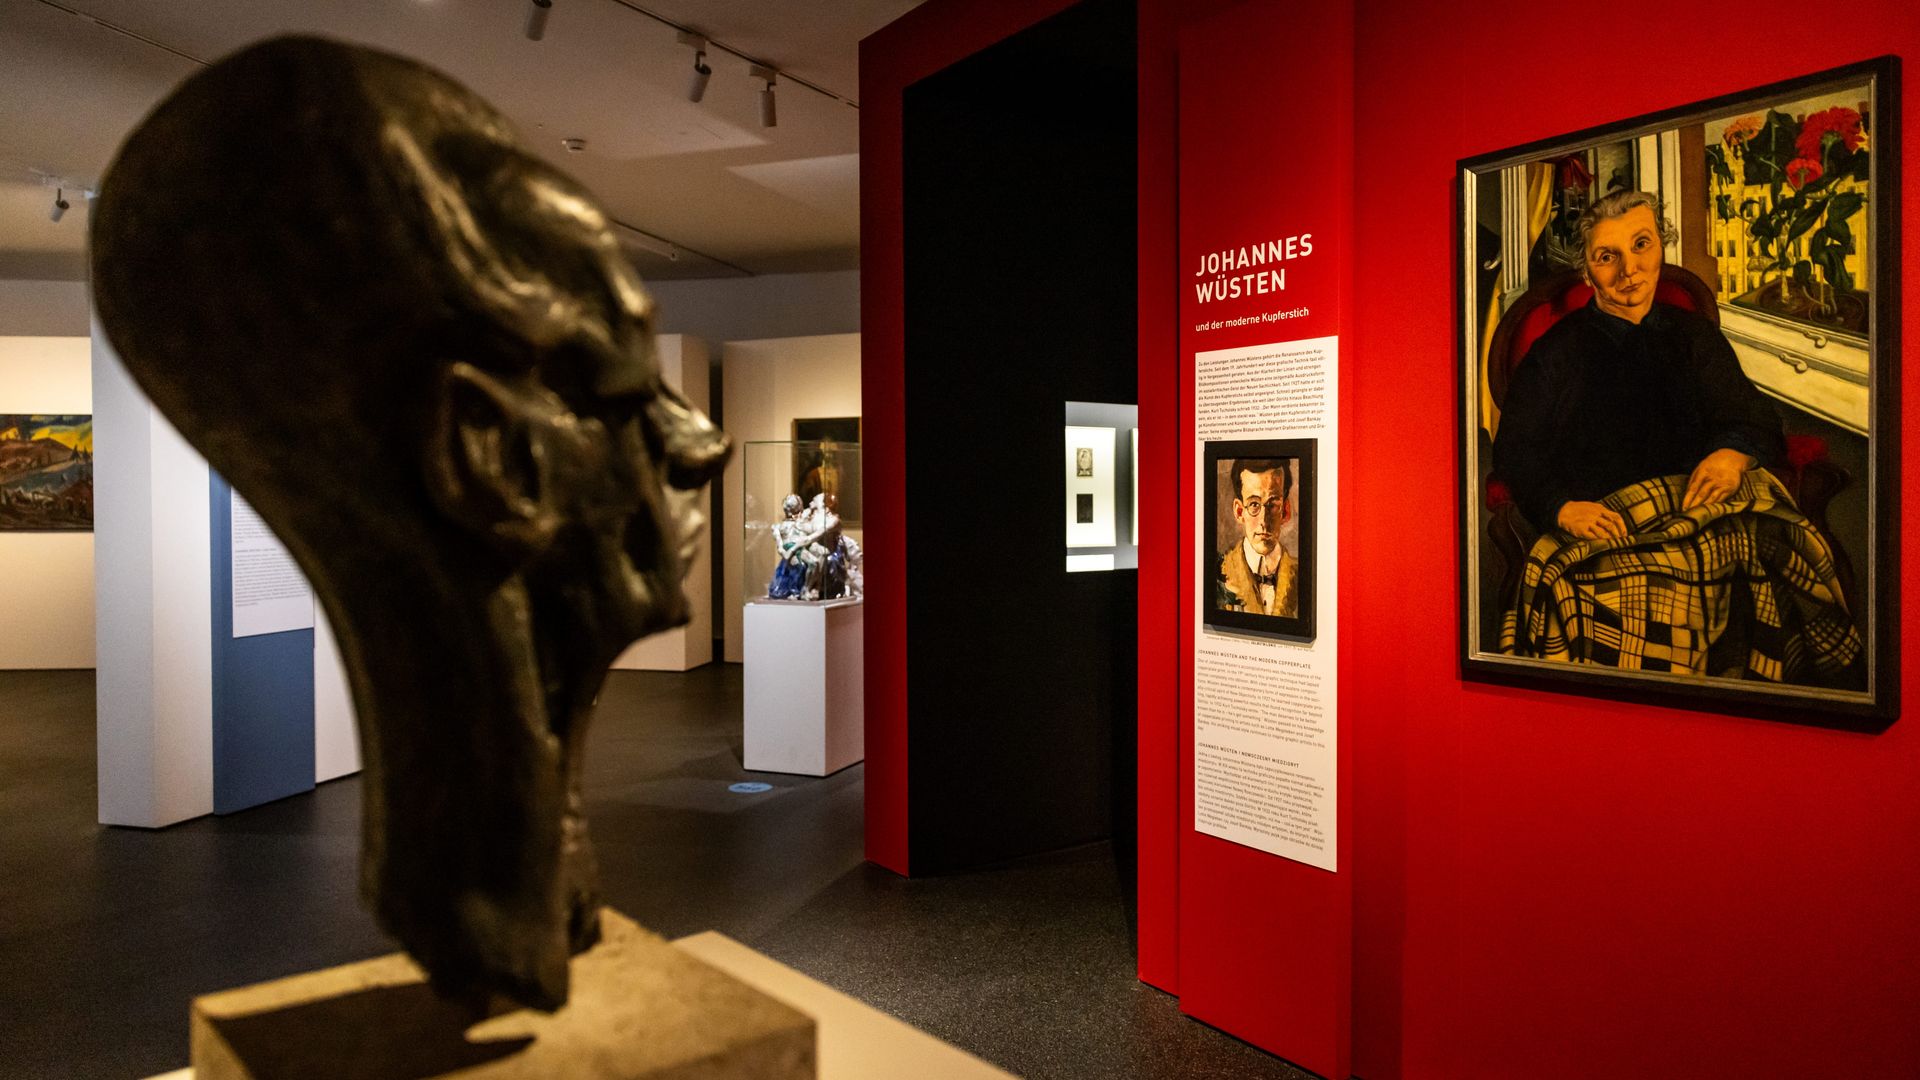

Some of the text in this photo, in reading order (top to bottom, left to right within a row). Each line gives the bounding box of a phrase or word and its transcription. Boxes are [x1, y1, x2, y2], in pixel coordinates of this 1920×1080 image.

[1196, 233, 1313, 276] JOHANNES
[1196, 268, 1286, 304] WÜSTEN
[1196, 307, 1309, 332] und der moderne Kupferstich
[1278, 660, 1310, 669] COPPERPLATE
[1198, 741, 1218, 750] JOHANNES
